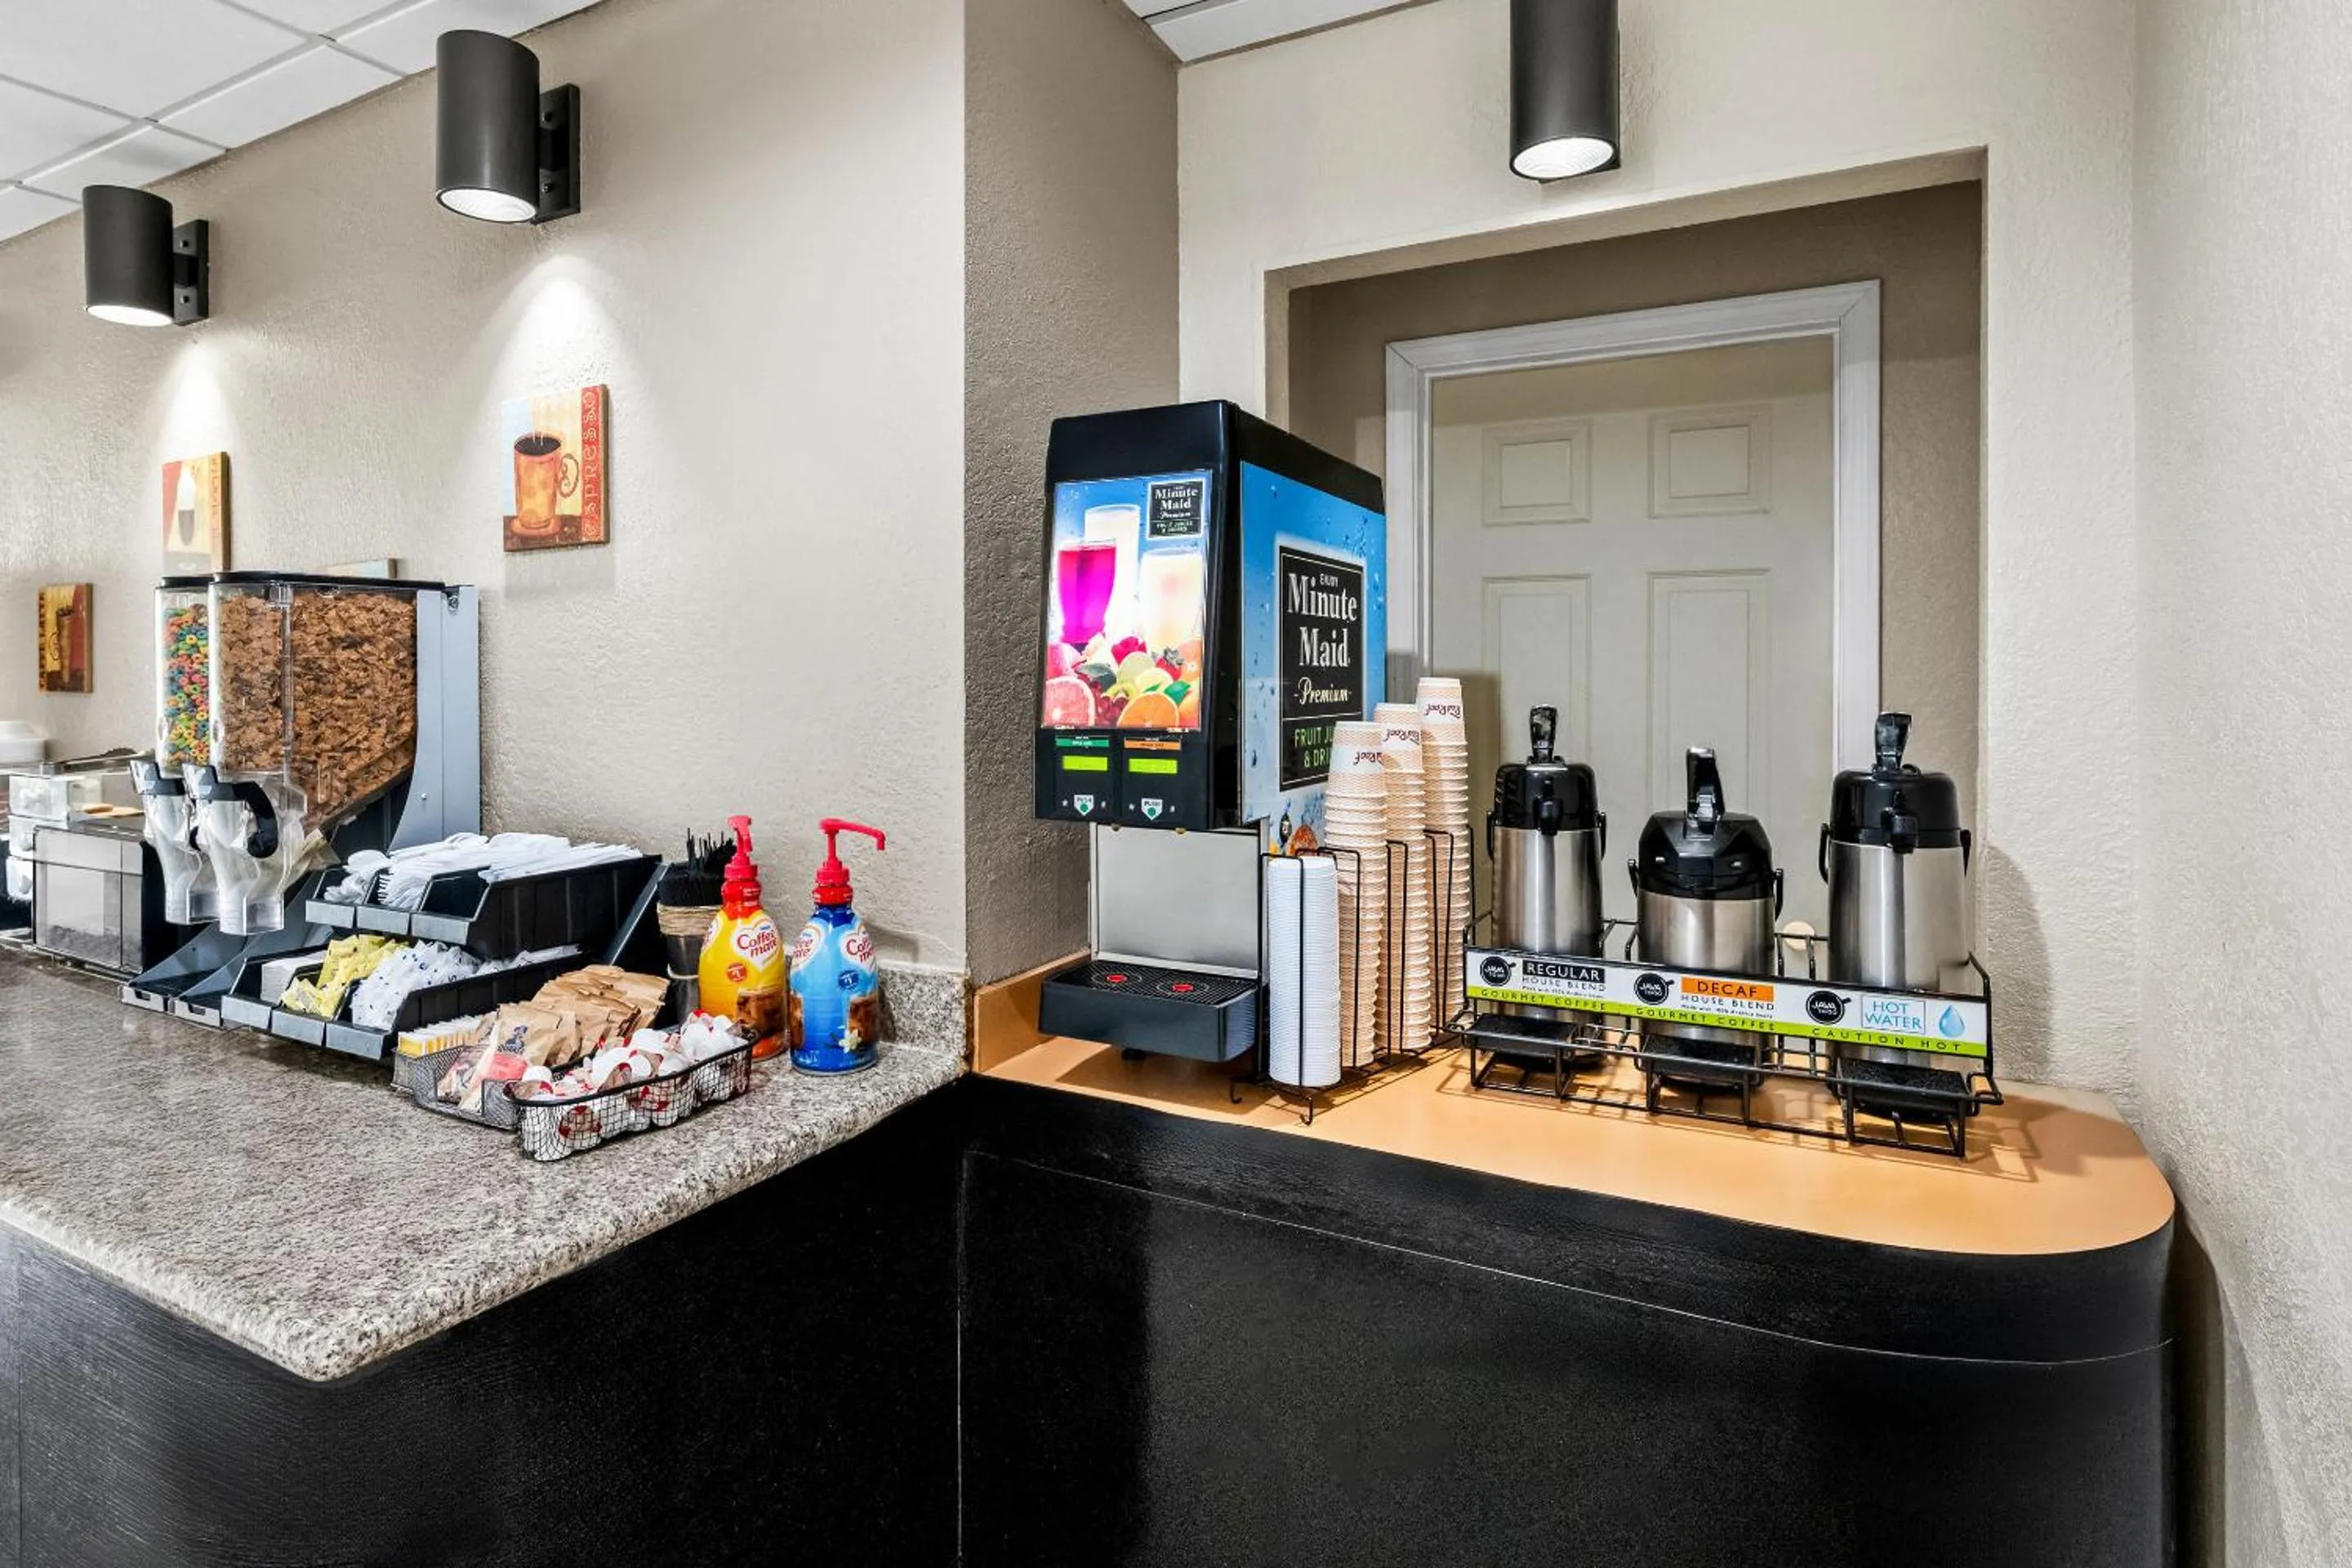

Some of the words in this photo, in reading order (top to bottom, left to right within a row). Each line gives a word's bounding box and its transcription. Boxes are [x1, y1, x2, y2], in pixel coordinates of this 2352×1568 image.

[1155, 488, 1199, 499] Minute
[1160, 497, 1192, 510] Maid
[1287, 572, 1358, 621] Minute
[1298, 626, 1350, 667] Maid
[1297, 676, 1349, 705] Premium
[1294, 726, 1322, 748] FRUIT
[1313, 747, 1330, 766] DRI
[1526, 962, 1600, 981] REGULAR
[1521, 976, 1561, 988] HOUSE
[1567, 981, 1606, 992] BLEND
[1696, 981, 1757, 998] DECAF
[1481, 989, 1546, 1004] GOURMET
[1553, 997, 1606, 1011] COFFEE
[1681, 995, 1725, 1006] HOUSE
[1731, 1000, 1775, 1011] BLEND
[1873, 1000, 1911, 1015] HOT
[1636, 1007, 1707, 1023] GOURMET
[1717, 1017, 1775, 1031] COFFEE
[1864, 1012, 1922, 1030] WATER
[1811, 1027, 1905, 1045] CAUTION
[1921, 1040, 1962, 1051] HOT
